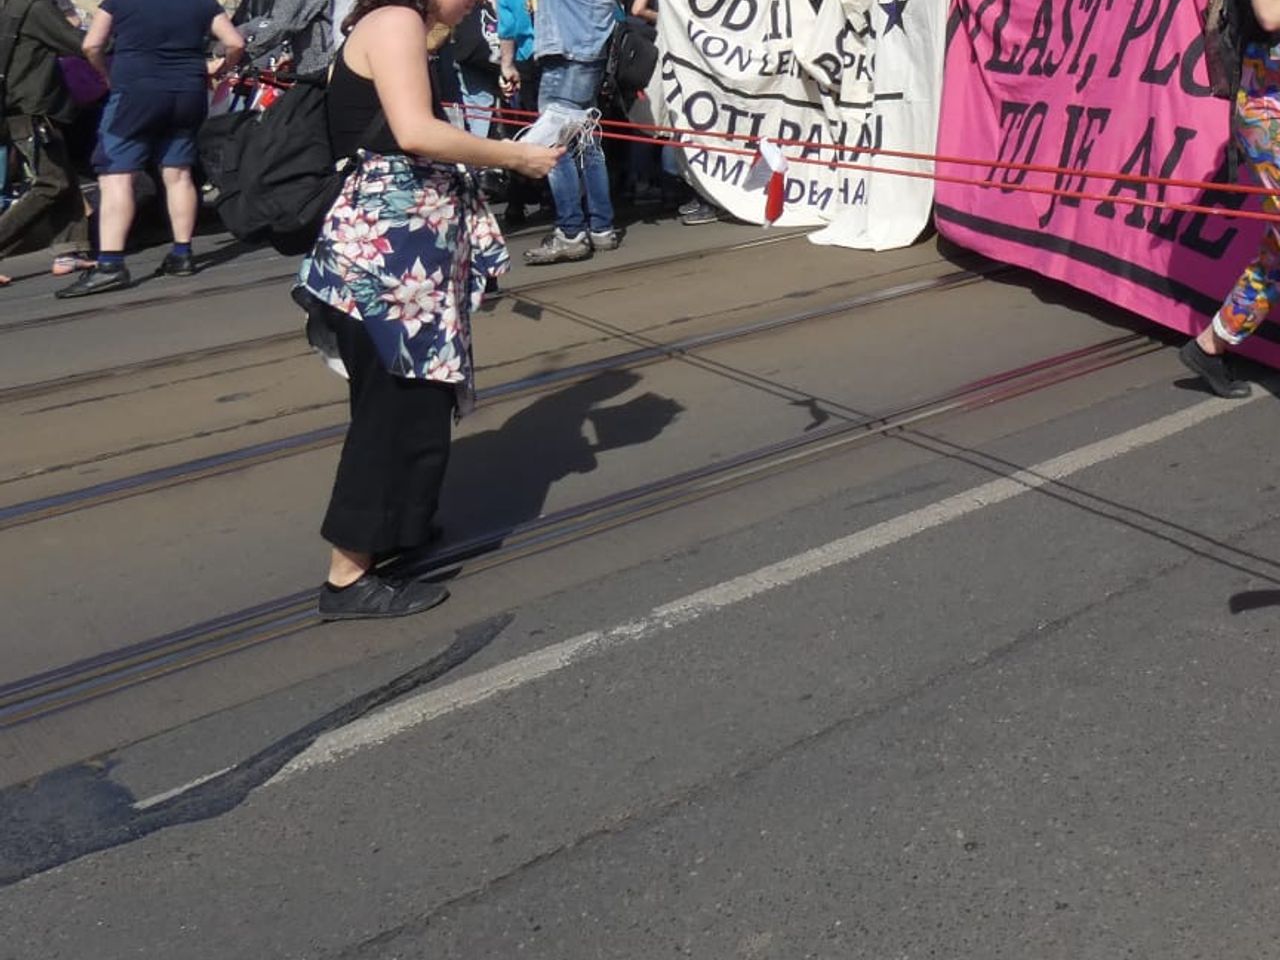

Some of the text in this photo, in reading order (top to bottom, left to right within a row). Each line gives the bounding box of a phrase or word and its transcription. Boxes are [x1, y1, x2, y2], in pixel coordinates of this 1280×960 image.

[981, 101, 1049, 194] TO
[1038, 104, 1112, 229] JE
[1094, 115, 1249, 260] ALE
